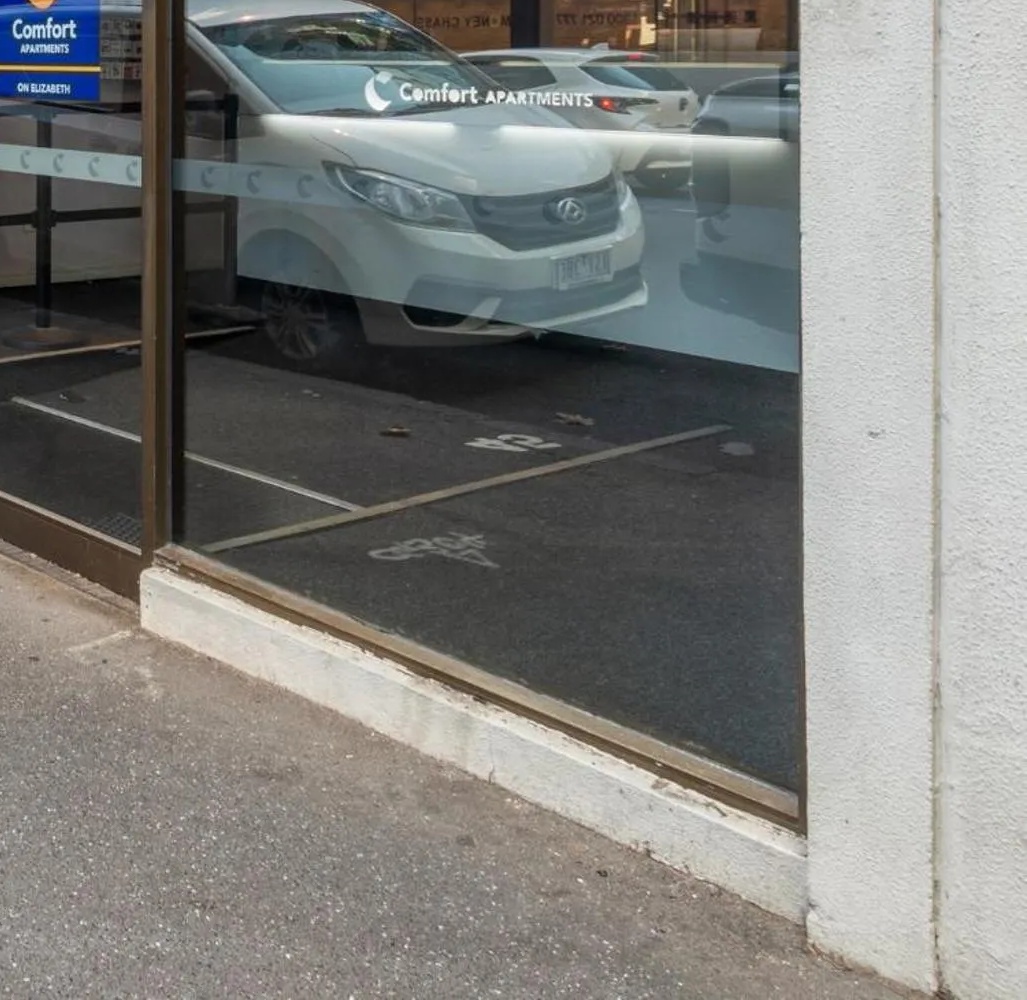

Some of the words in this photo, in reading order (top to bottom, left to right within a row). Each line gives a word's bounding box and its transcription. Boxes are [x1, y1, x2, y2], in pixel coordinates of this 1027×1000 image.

[12, 17, 77, 39] Comfort
[20, 44, 69, 54] APARTMENTS
[17, 82, 29, 93] ON
[31, 83, 71, 94] ELIZABETH
[399, 82, 478, 104] Comfort
[485, 90, 594, 108] APARTMENTS
